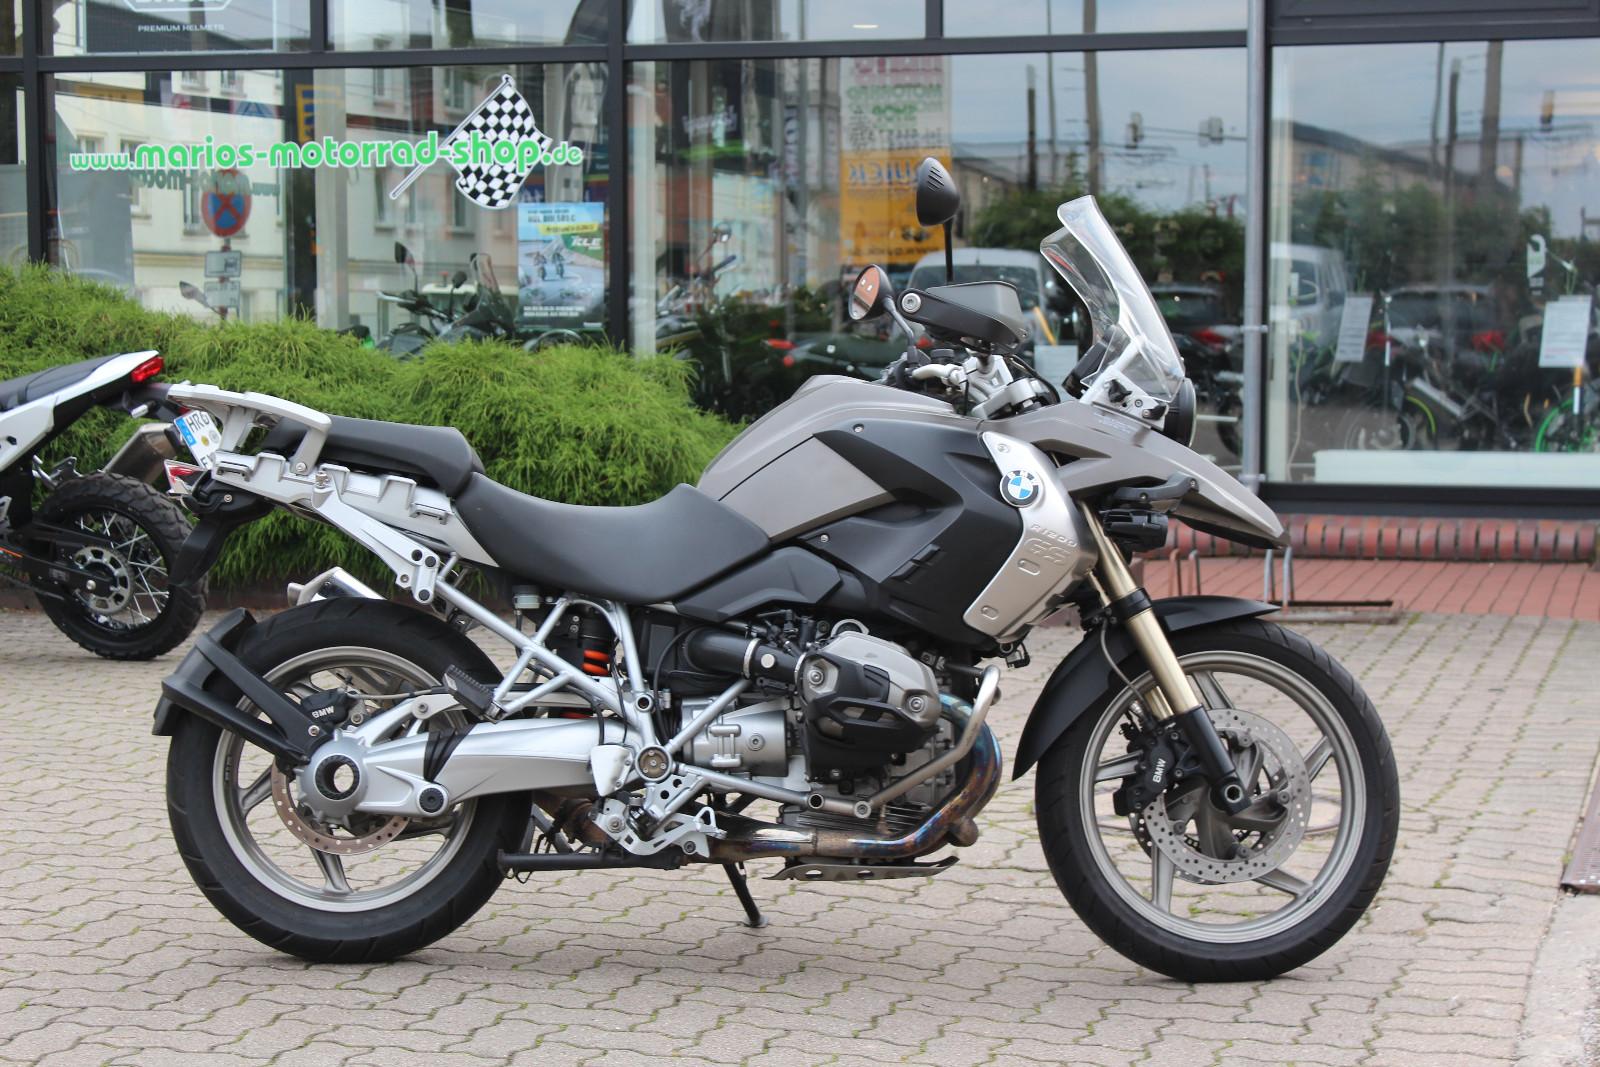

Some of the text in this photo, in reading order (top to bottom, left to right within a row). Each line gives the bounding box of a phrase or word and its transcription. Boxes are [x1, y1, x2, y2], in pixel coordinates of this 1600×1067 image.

[138, 23, 225, 32] PREMIUM HELMETS
[70, 130, 583, 173] www.marios-motorrad-shop.de
[312, 705, 334, 718] BMW
[1153, 758, 1166, 783] BMW
